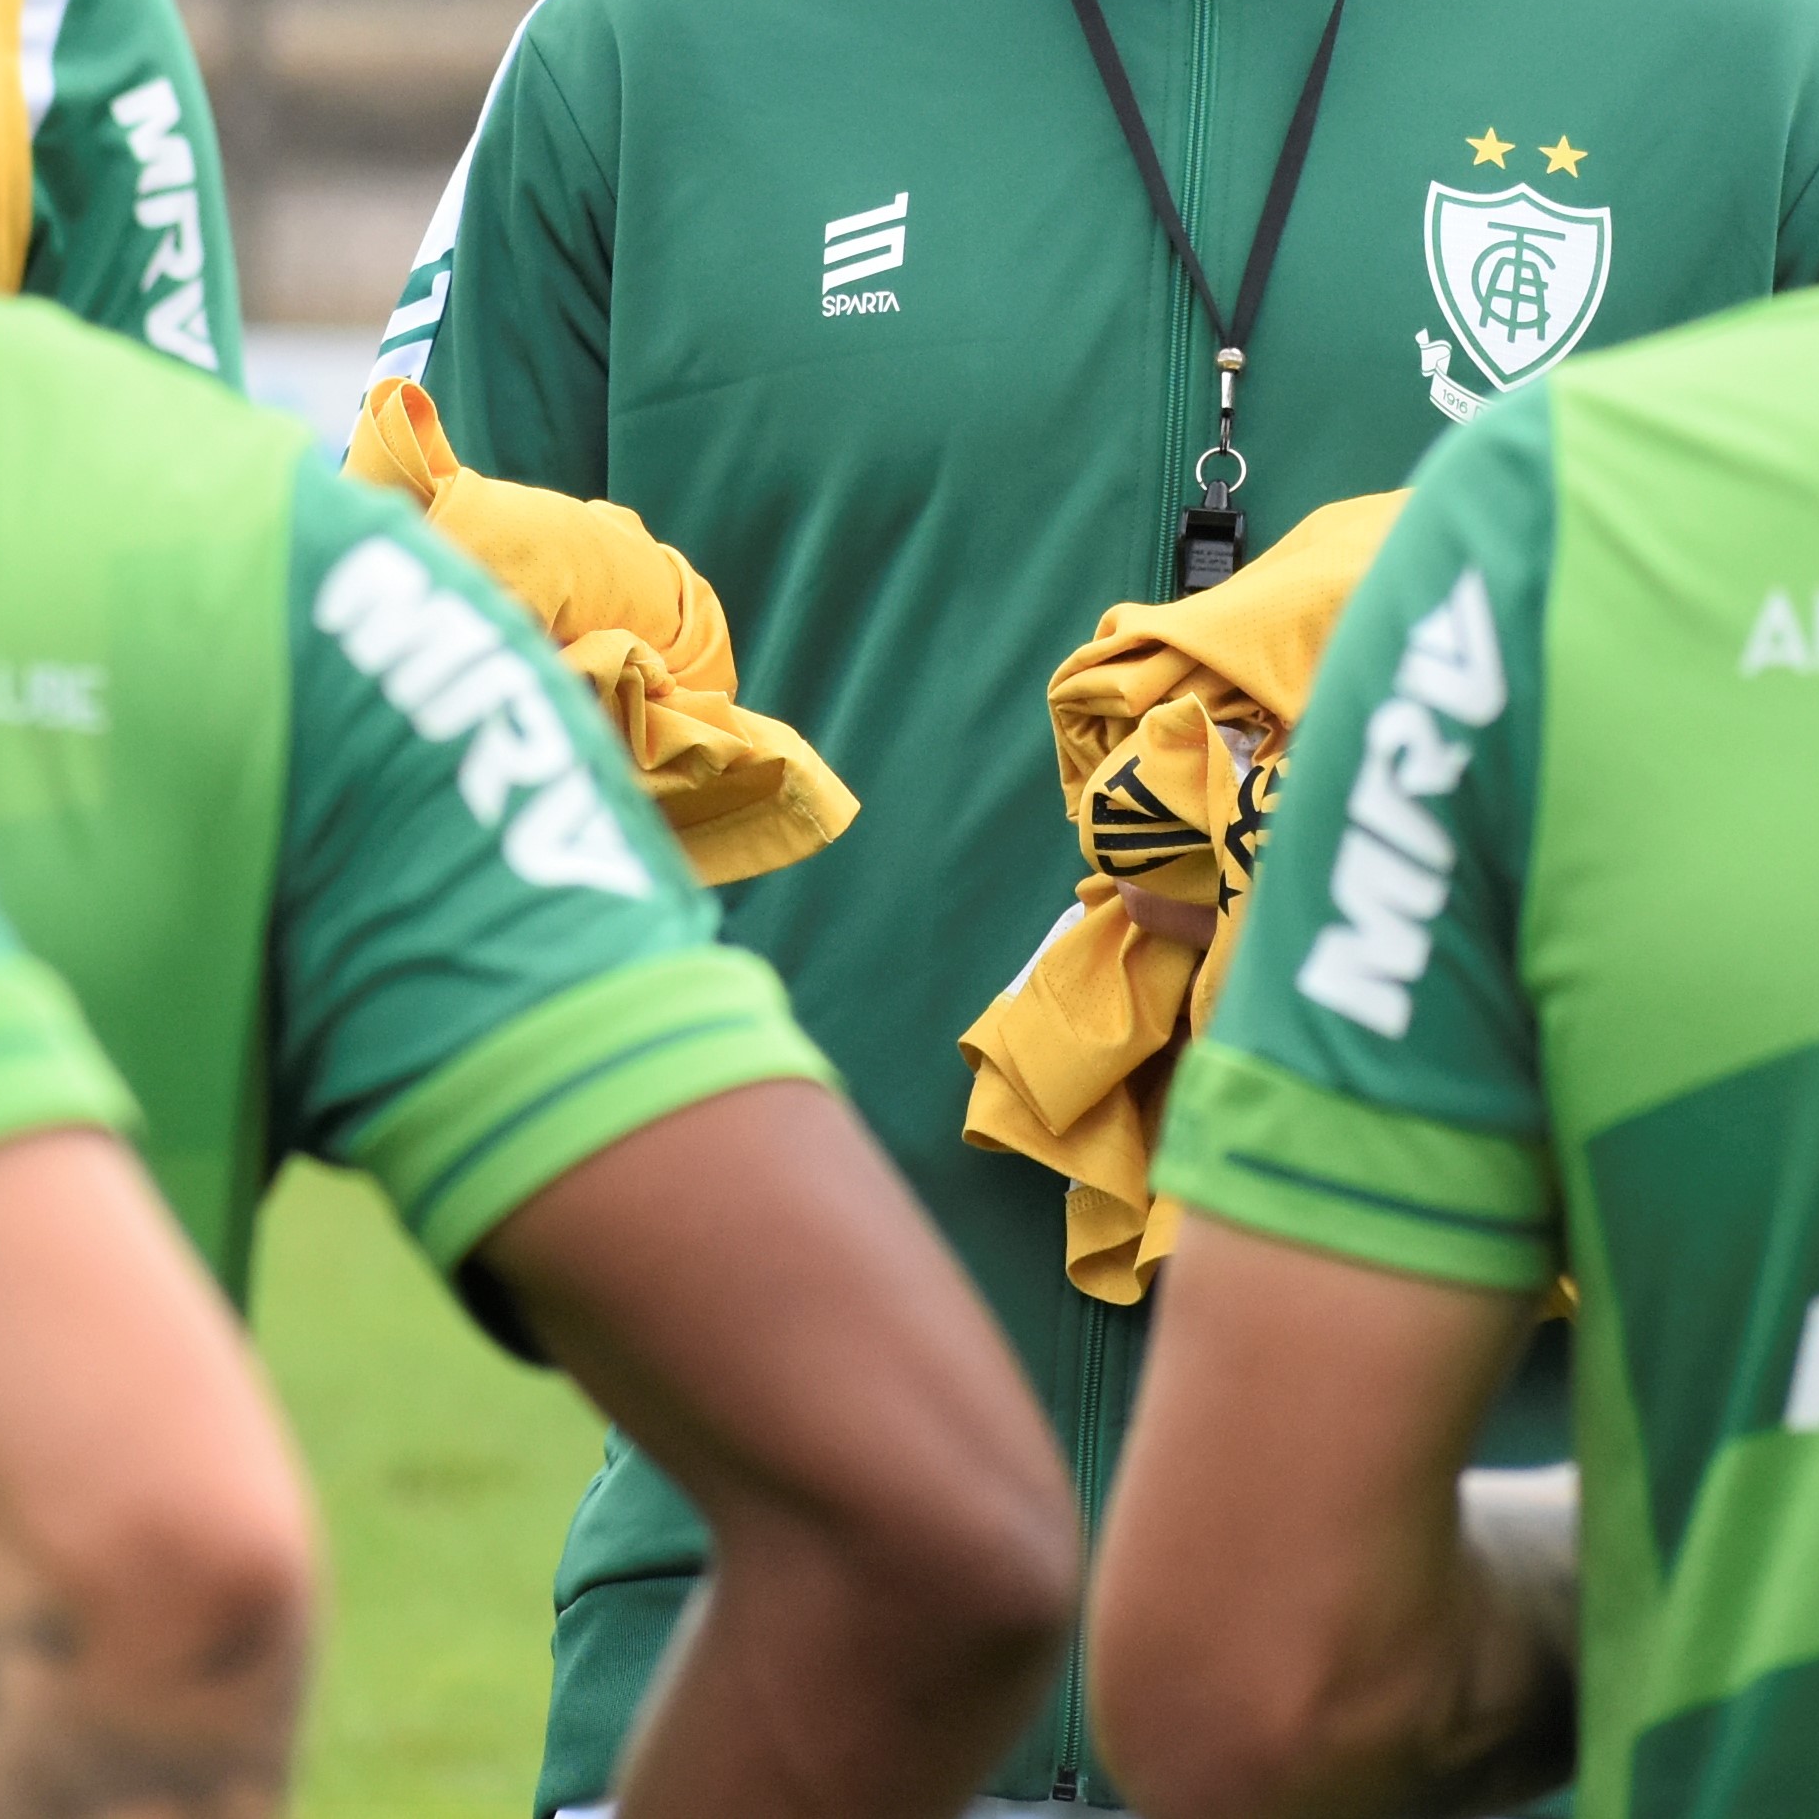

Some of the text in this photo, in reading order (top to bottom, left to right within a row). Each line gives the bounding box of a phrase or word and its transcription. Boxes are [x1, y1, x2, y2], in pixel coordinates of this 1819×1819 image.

[109, 76, 220, 372] MRV
[821, 290, 900, 318] SPARTA
[1442, 388, 1469, 415] 1916
[314, 534, 652, 902] MRV
[1297, 568, 1508, 1042] MRV
